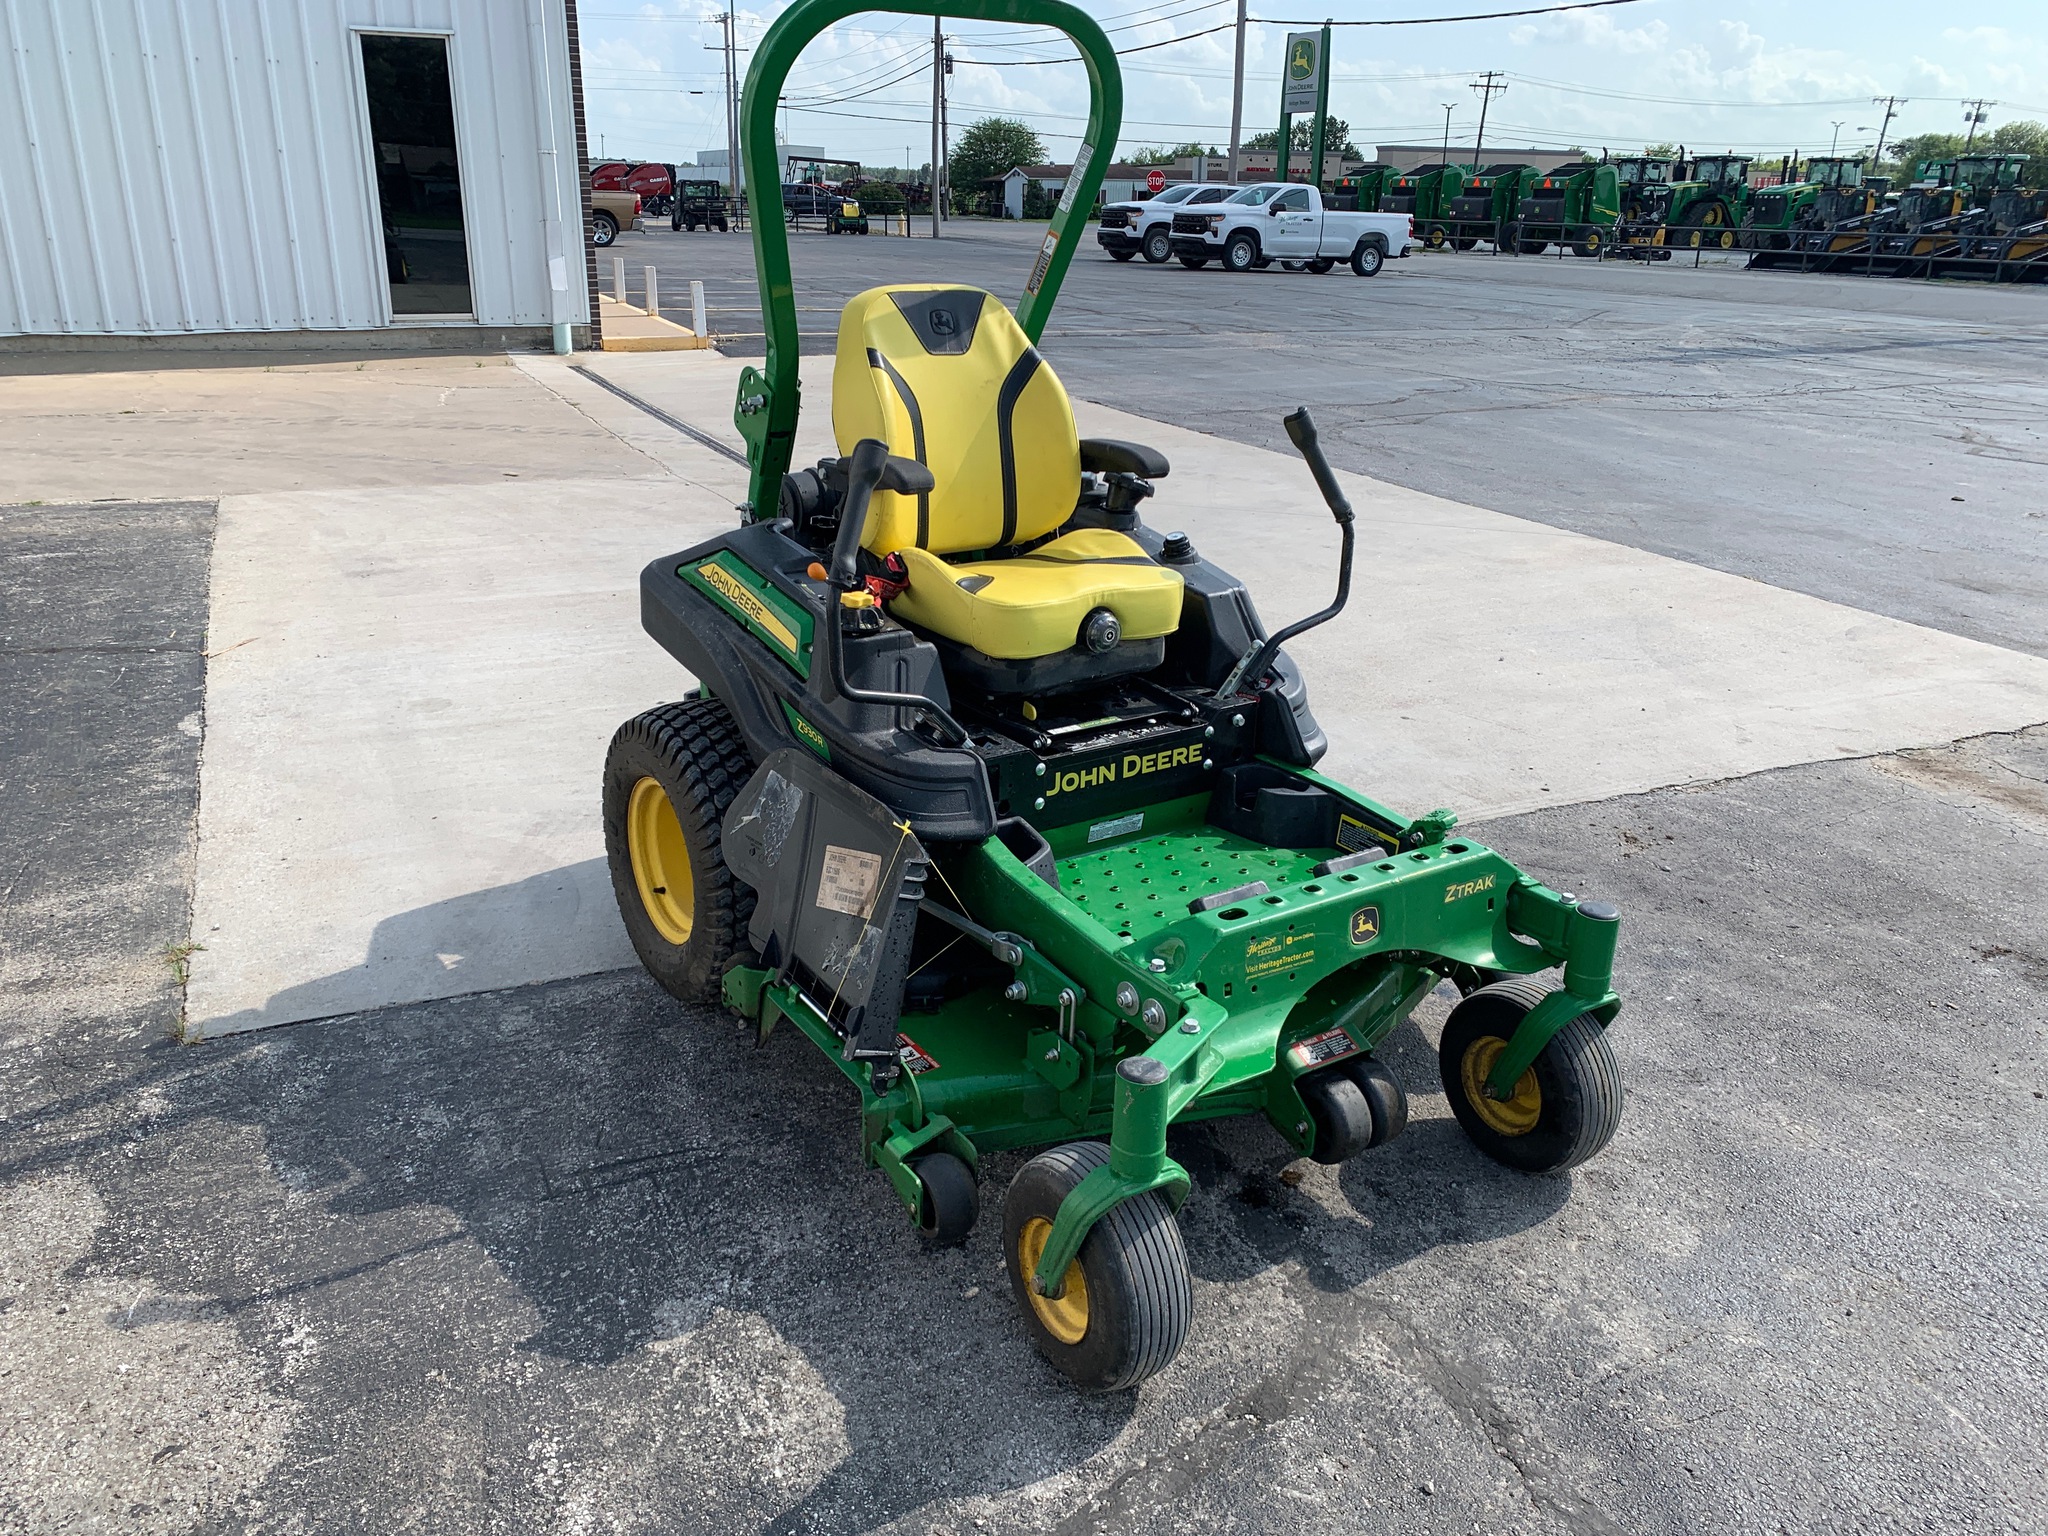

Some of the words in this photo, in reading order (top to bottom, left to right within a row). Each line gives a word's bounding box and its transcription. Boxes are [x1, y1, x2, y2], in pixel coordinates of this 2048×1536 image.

[1148, 177, 1164, 185] STOP
[706, 566, 732, 595] JOHN
[732, 584, 763, 620] DEERE
[1046, 763, 1116, 797] JOHN
[1122, 743, 1203, 779] DEERE
[1444, 874, 1495, 903] ZTRAK
[1246, 964, 1258, 973] Visit
[1259, 950, 1315, 971] HeritageTractor.com
